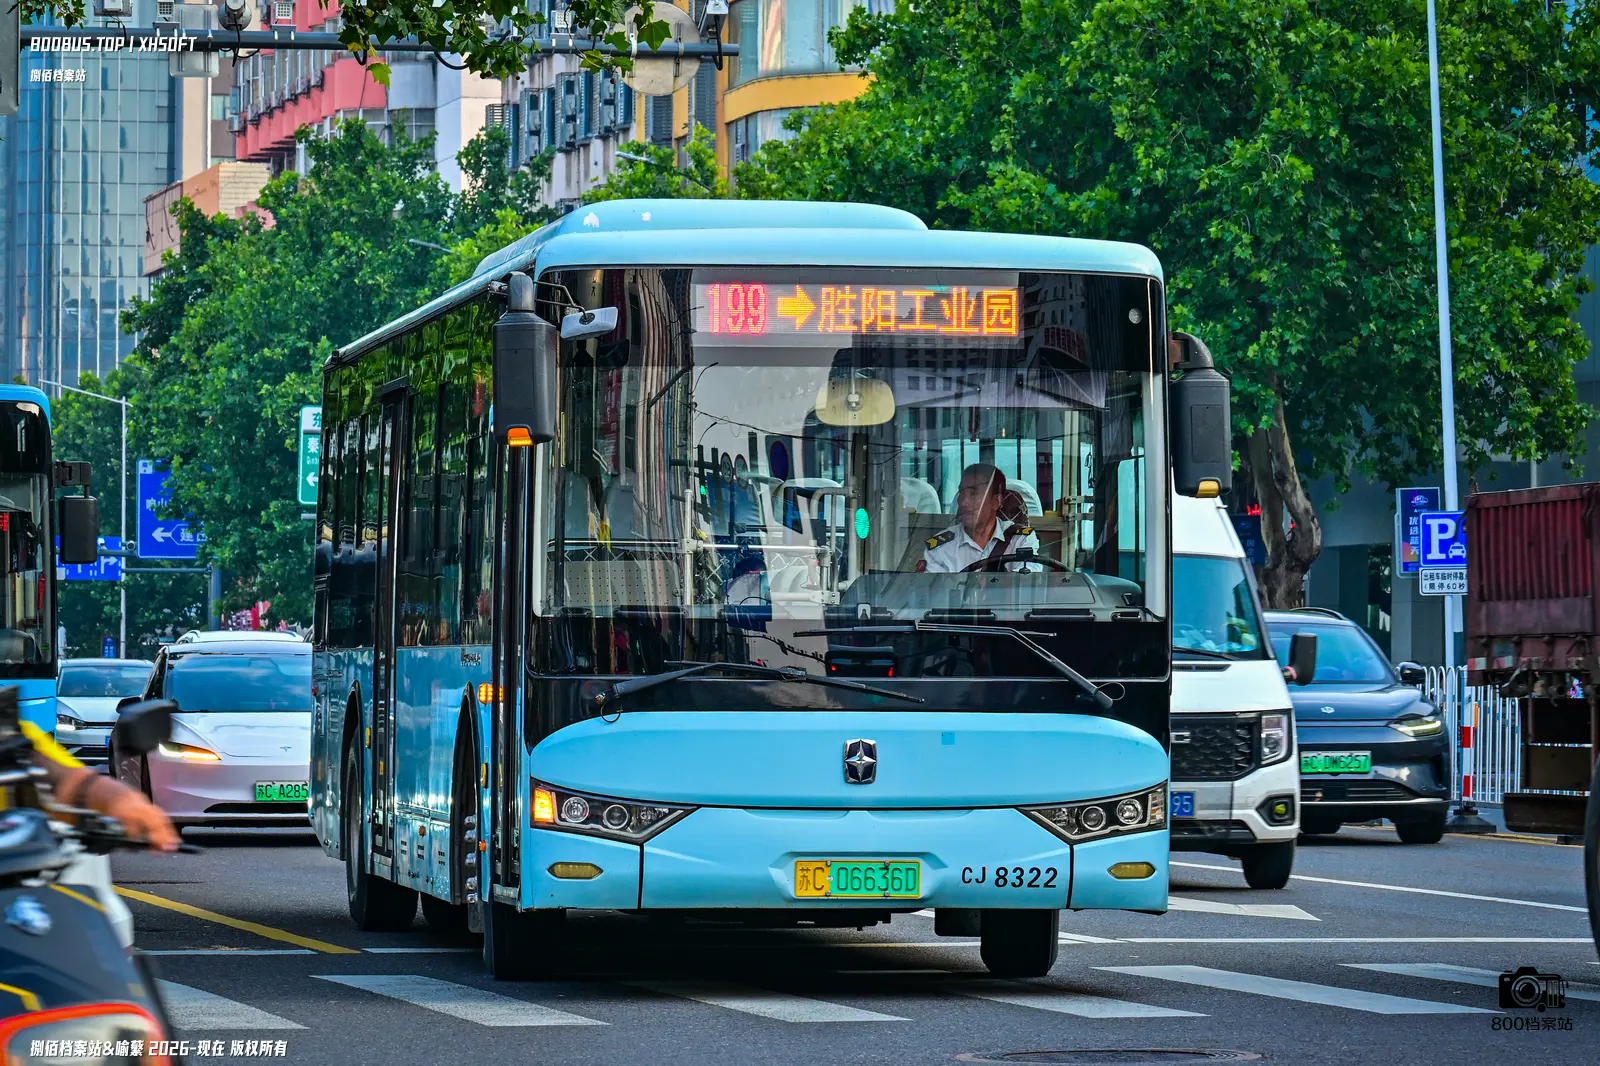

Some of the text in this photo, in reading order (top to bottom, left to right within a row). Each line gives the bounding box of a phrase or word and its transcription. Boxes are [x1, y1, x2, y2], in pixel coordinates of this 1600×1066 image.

[707, 283, 1018, 336] 199 胜阳工业园
[1425, 518, 1457, 560] P
[1172, 795, 1193, 813] 95
[961, 866, 1059, 889] CJ 8322
